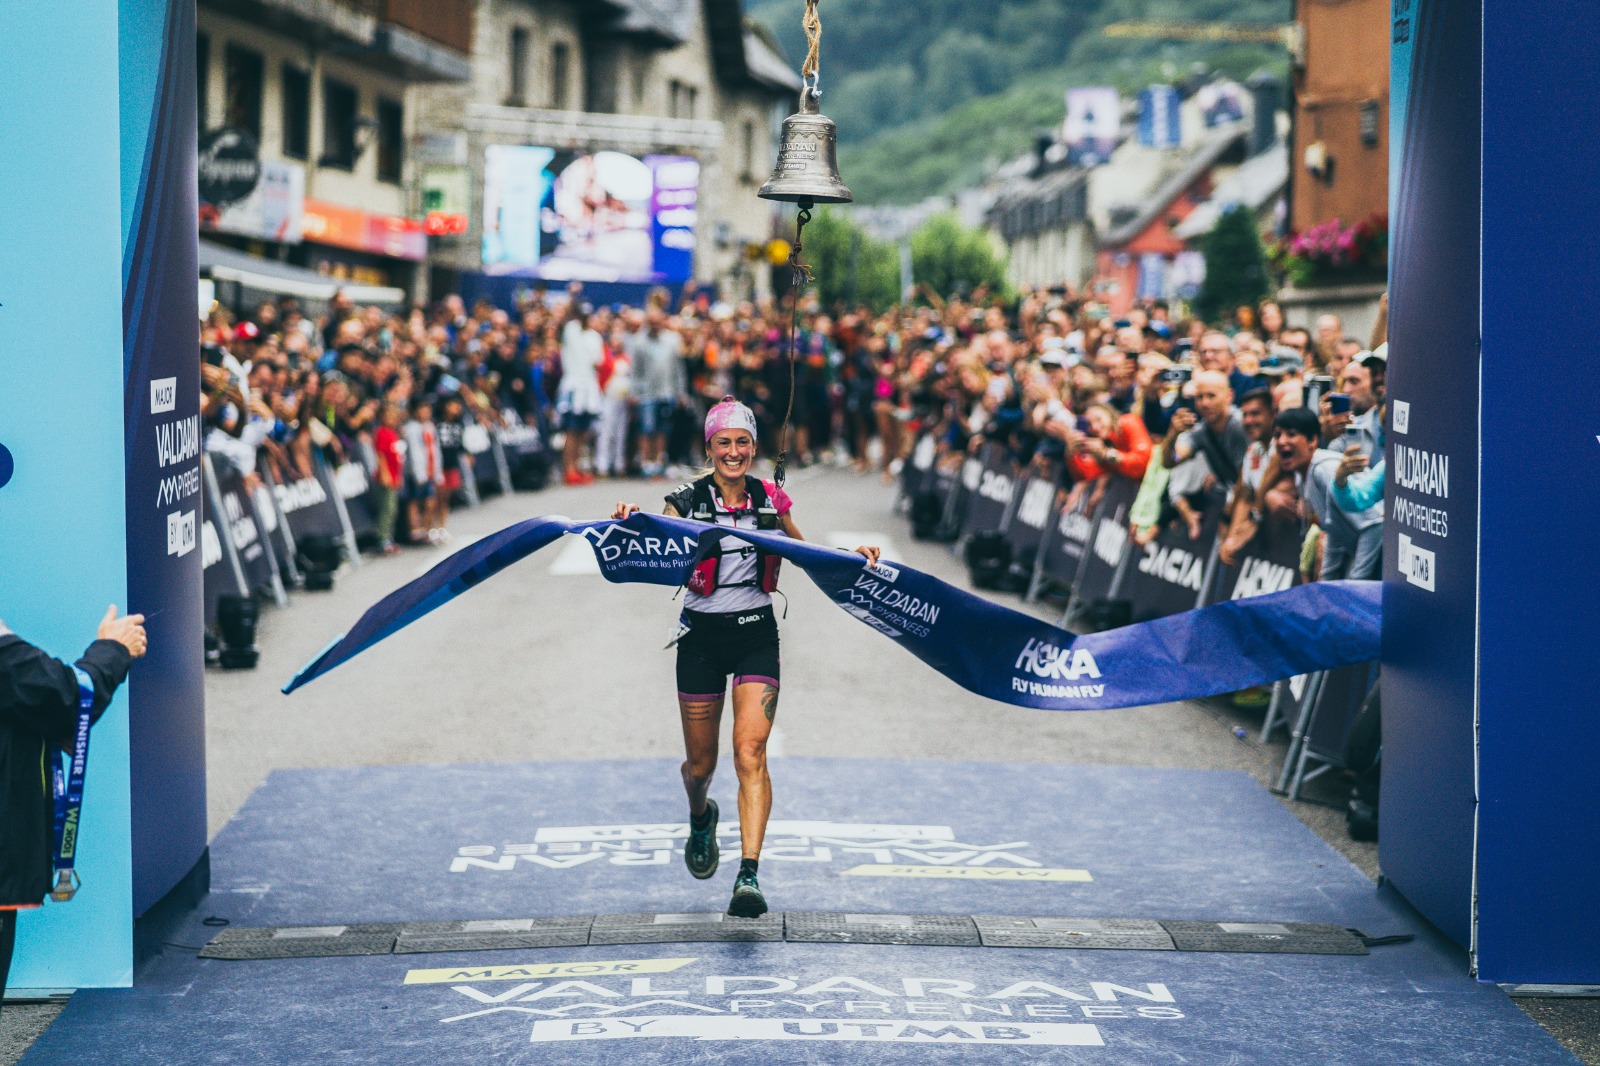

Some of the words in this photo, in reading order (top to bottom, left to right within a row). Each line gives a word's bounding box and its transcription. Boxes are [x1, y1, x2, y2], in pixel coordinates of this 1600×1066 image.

[155, 386, 172, 406] MAJOR
[1409, 502, 1448, 538] PYRENEES
[618, 559, 647, 568] esencia
[649, 560, 659, 568] de
[660, 560, 671, 568] los
[869, 565, 893, 580] MAJOR
[1412, 554, 1429, 581] UTMB
[875, 605, 930, 638] PYRENEES
[1015, 637, 1102, 680] HOKA
[1012, 676, 1028, 693] FLY
[1029, 681, 1081, 699] HUMAN
[1079, 684, 1105, 698] FLY
[73, 714, 90, 775] FINISHER
[63, 827, 75, 855] 100K
[891, 868, 1050, 877] MAJOR
[449, 964, 641, 981] MAJOR
[730, 999, 1186, 1020] PYRENEES
[570, 1019, 660, 1036] BY
